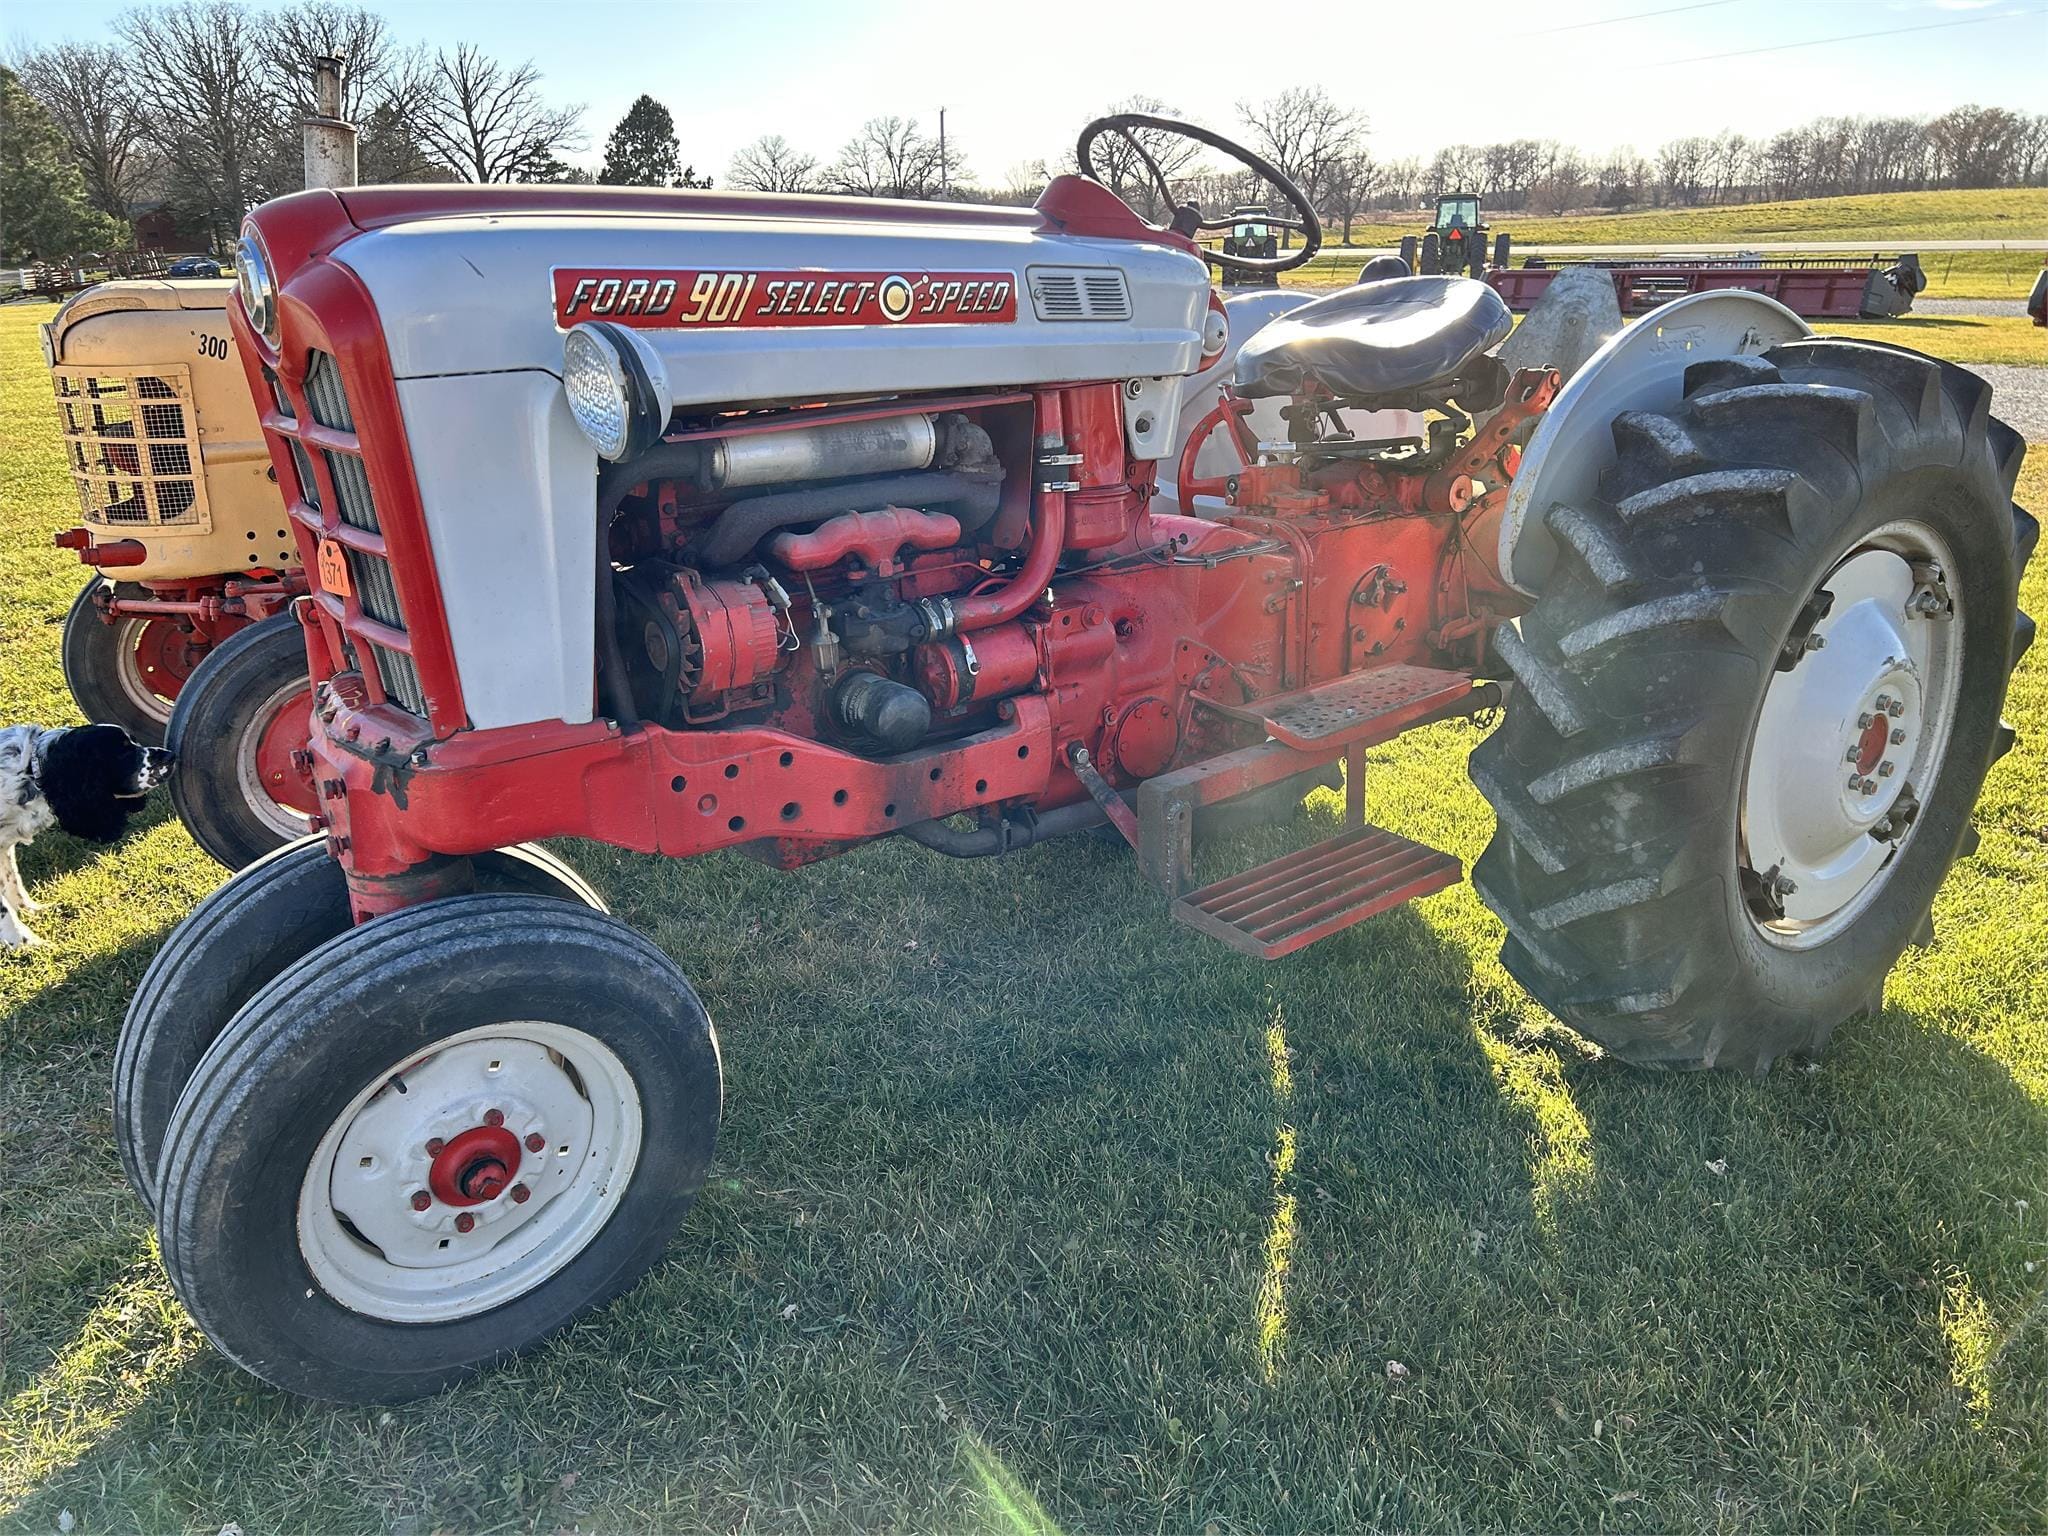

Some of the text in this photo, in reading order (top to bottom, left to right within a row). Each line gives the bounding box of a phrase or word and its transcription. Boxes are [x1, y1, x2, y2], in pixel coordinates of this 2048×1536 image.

[565, 279, 677, 316] FORD
[680, 273, 757, 322] 901
[198, 333, 228, 361] 300
